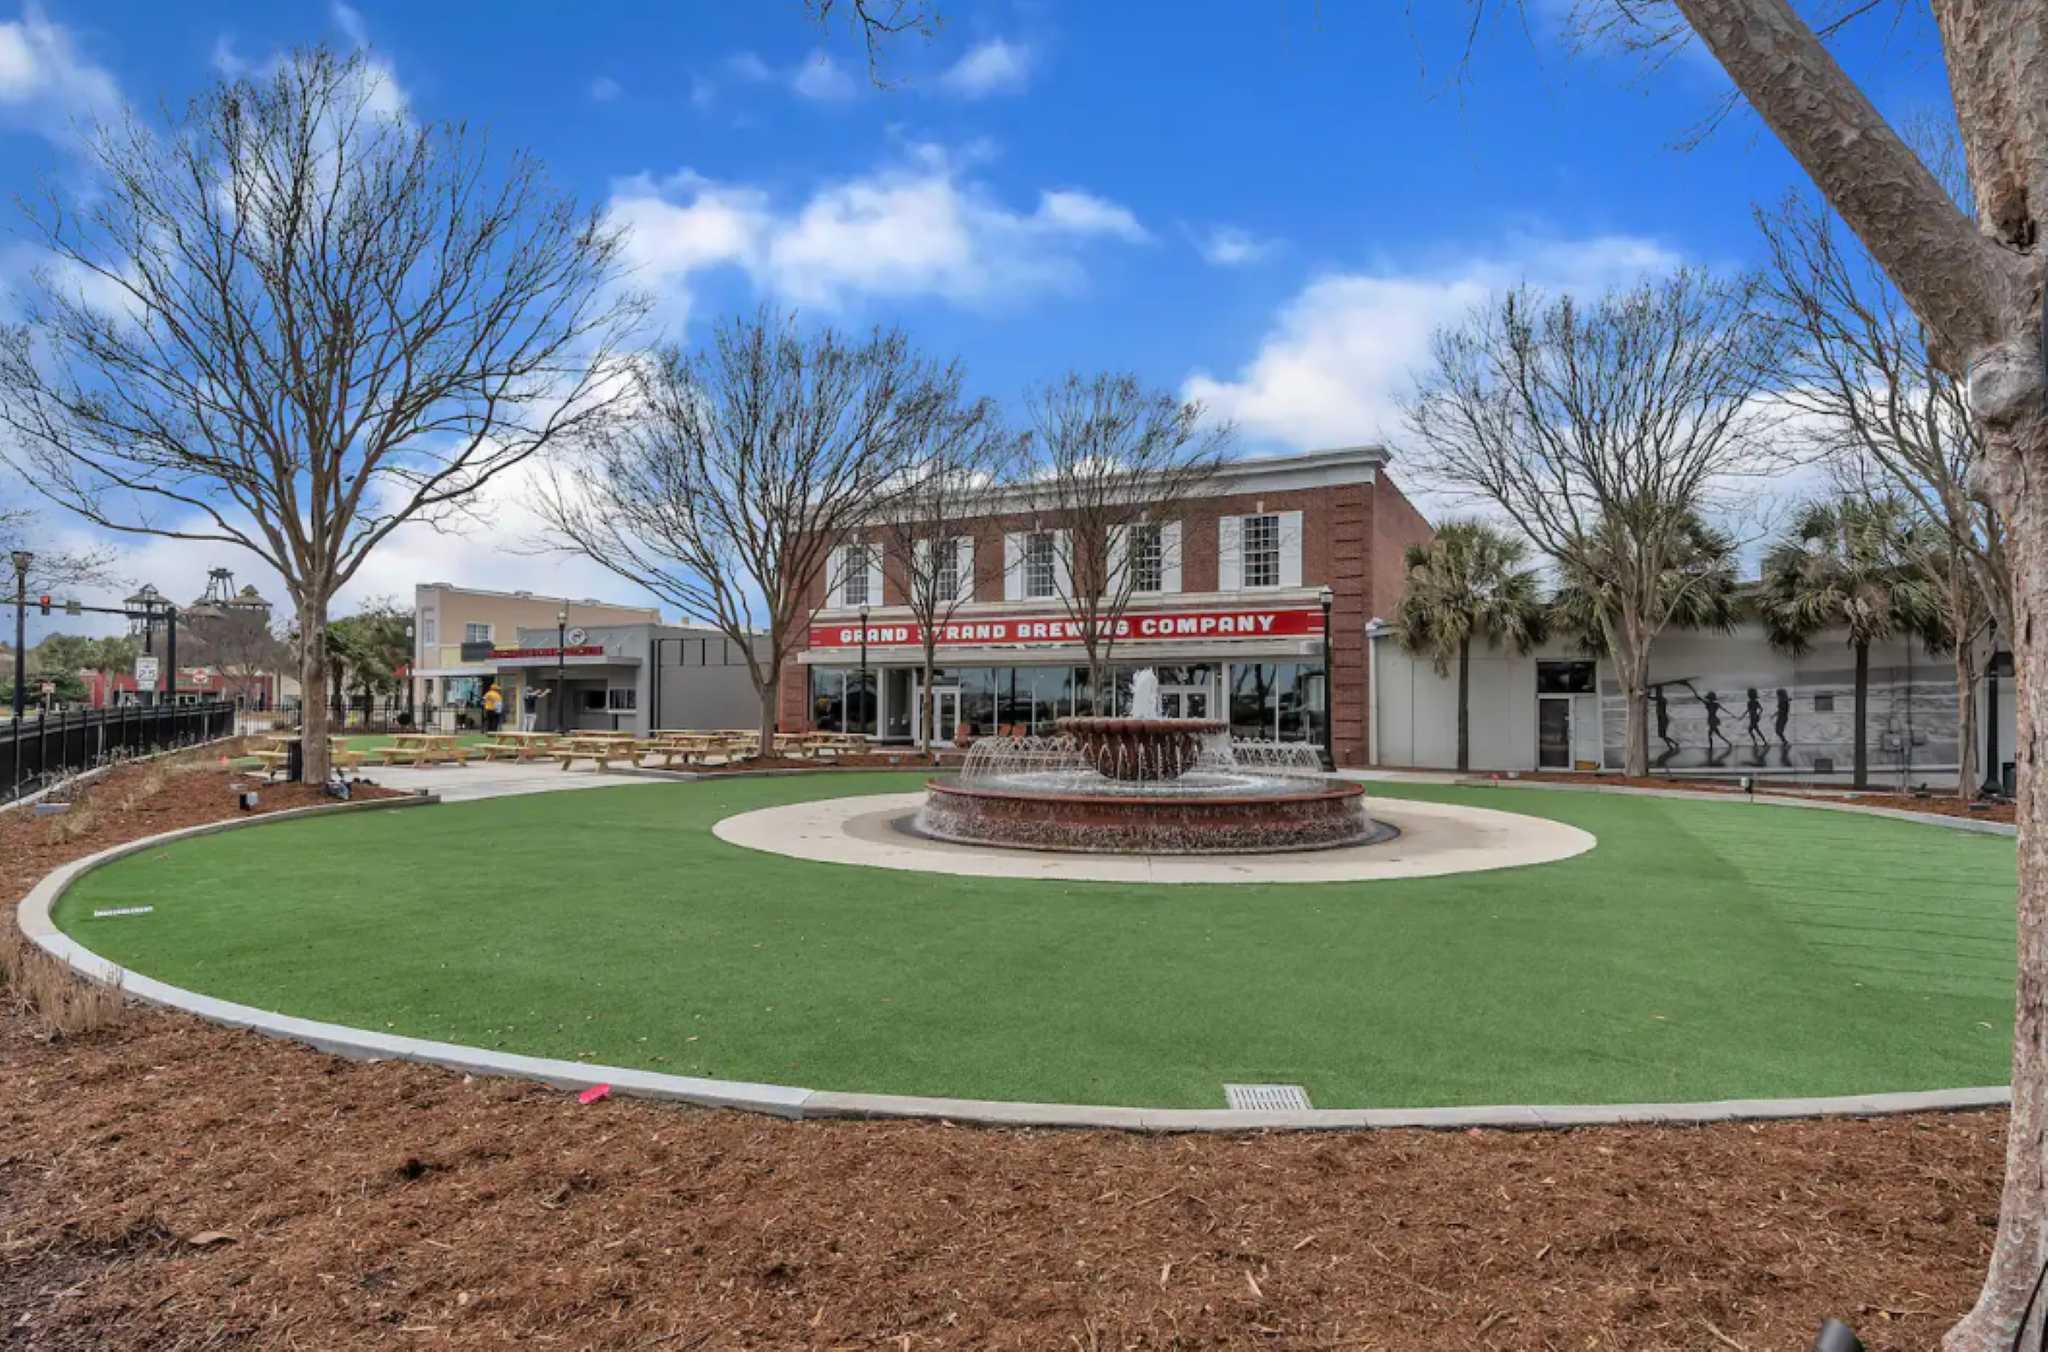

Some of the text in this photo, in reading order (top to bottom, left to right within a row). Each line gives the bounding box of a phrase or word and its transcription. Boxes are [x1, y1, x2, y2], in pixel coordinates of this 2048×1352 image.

[840, 615, 1276, 643] GRAND TRAND BREWNG COMPANY
